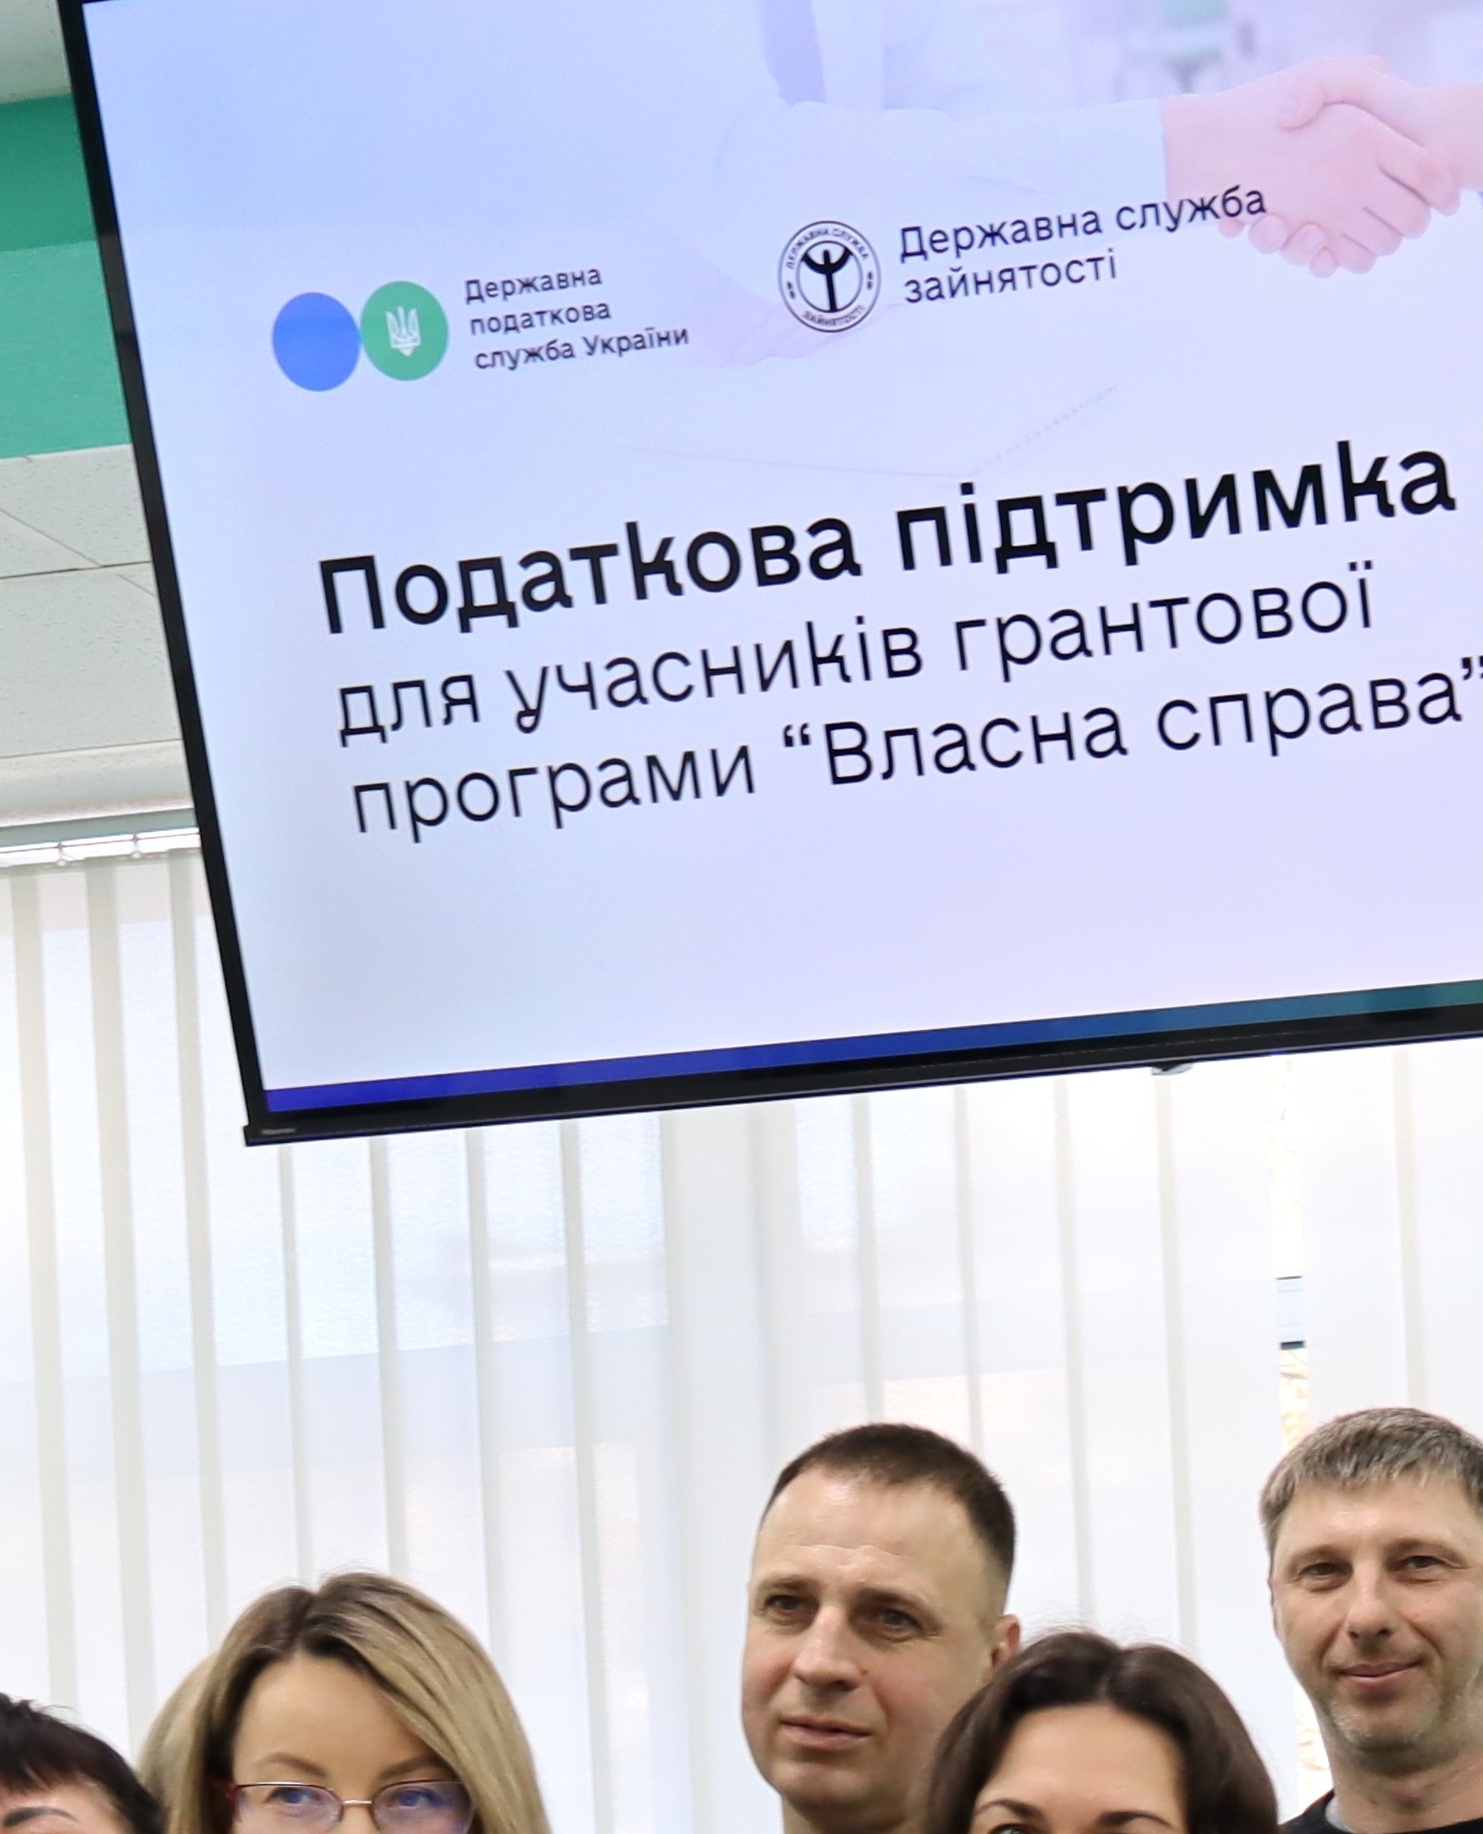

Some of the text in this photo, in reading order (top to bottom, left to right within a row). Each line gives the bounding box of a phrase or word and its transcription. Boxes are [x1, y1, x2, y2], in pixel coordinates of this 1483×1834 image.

[900, 184, 1267, 263] Державна служба
[465, 268, 603, 304] Державна
[905, 248, 1117, 303] зайнятості
[470, 302, 612, 335] податкова
[474, 326, 689, 371] служба України
[320, 440, 1457, 634] Податкова підтримка
[339, 560, 1374, 748] для учасників грантової
[353, 745, 755, 844] програми
